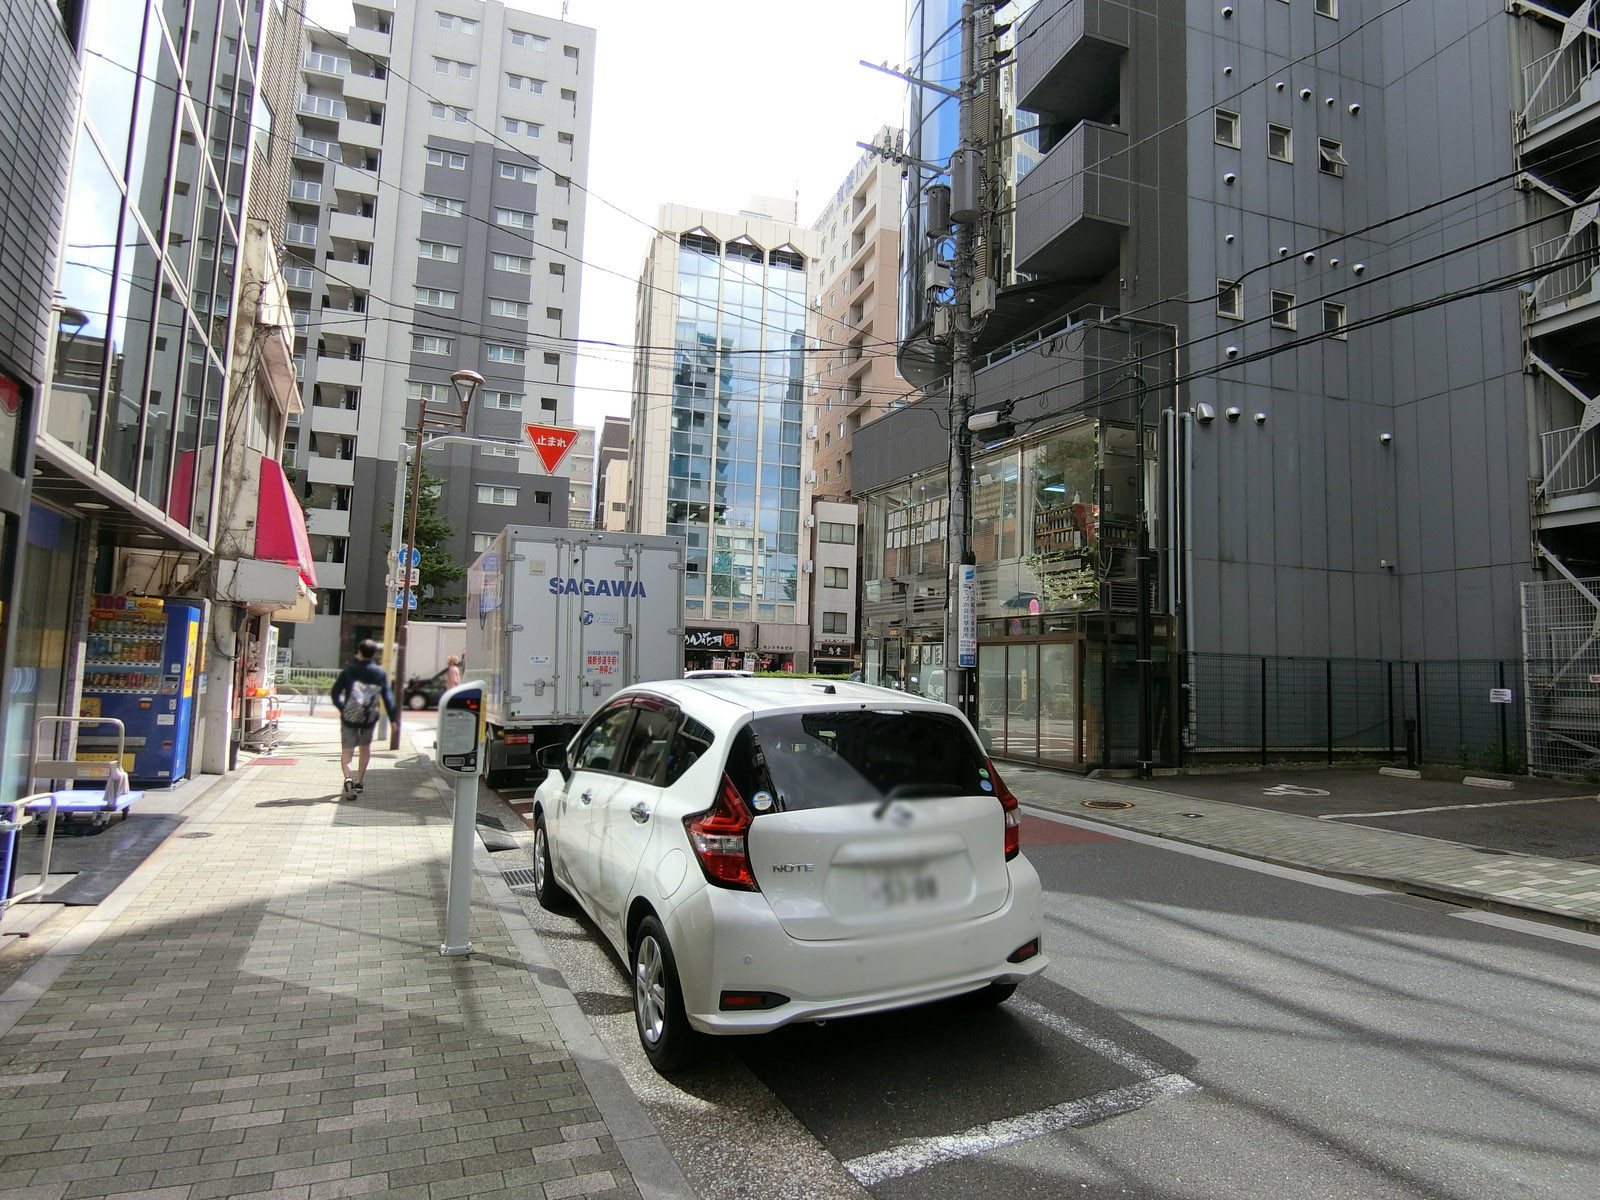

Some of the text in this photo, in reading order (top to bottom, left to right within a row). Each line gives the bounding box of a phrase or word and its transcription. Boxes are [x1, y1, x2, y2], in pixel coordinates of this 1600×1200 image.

[536, 435, 567, 448] 止まれ
[549, 577, 647, 598] SAGAWA
[773, 863, 814, 873] NOTE
